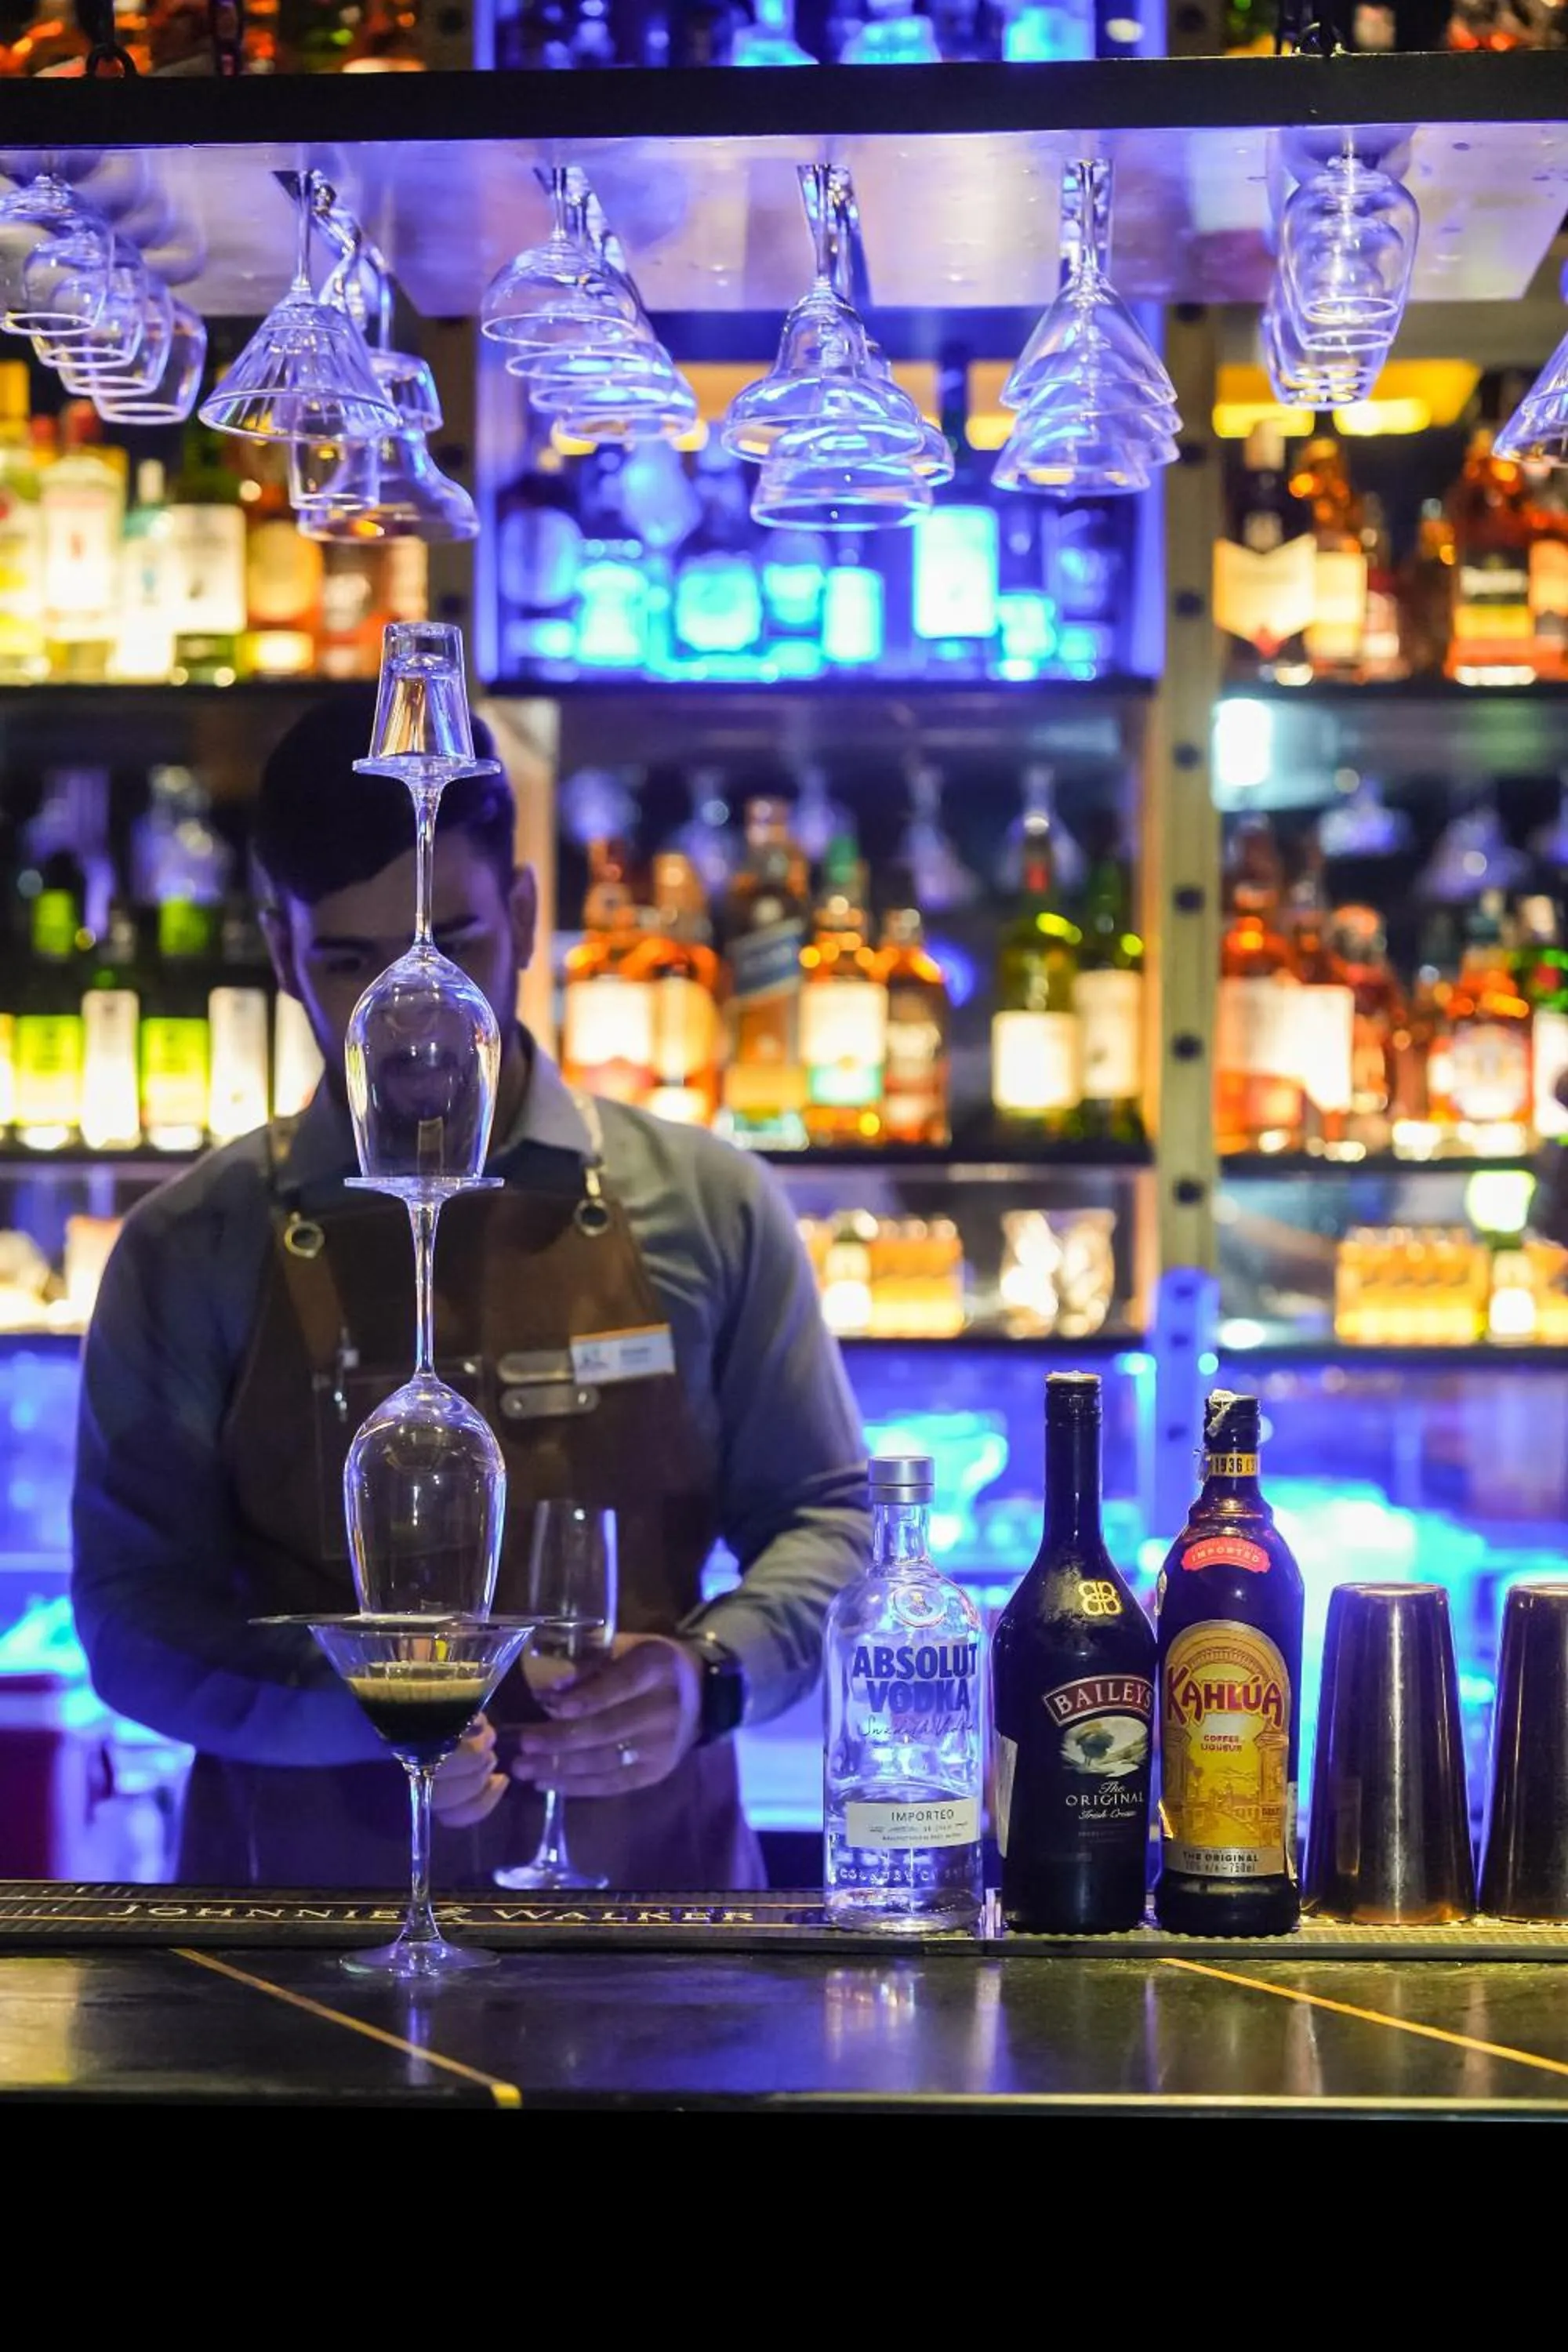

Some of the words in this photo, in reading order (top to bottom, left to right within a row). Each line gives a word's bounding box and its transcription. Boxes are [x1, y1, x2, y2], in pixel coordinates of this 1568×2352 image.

[852, 1642, 978, 1679] ABSOLUT
[866, 1678, 971, 1713] VODKA
[1054, 1682, 1152, 1715] BAILEYS
[1166, 1665, 1284, 1728] KAHLÚA
[1098, 1780, 1126, 1794] The
[1065, 1791, 1143, 1806] ORIGINAL
[891, 1808, 955, 1822] IMPORTED
[1182, 1851, 1202, 1860] THE
[1204, 1853, 1259, 1862] ORIGINAL
[107, 1904, 401, 1919] JOHNNIE
[492, 1908, 754, 1922] WALKER
